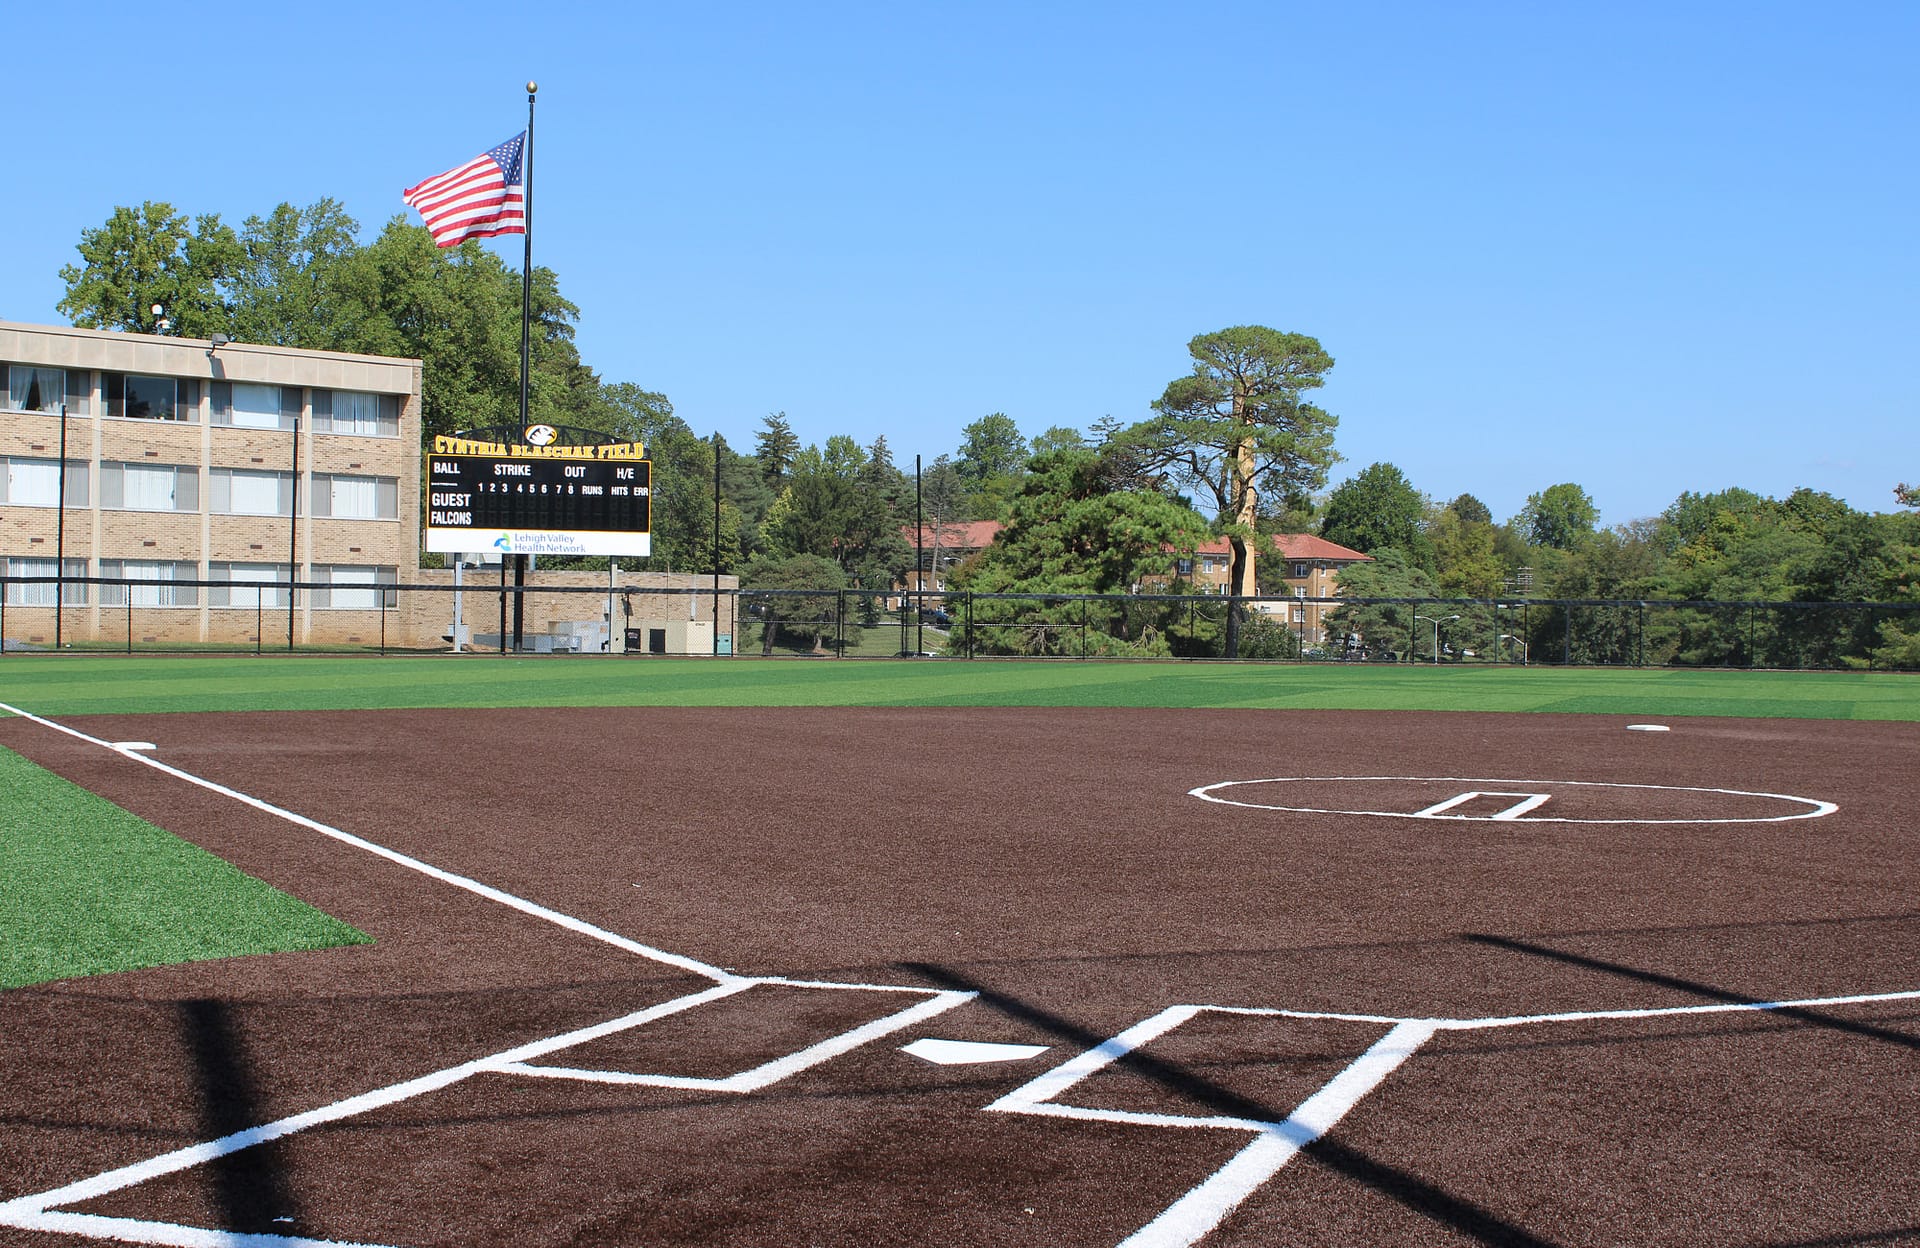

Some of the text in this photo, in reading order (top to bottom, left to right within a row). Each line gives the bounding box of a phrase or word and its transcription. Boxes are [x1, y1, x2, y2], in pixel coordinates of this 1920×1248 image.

[435, 435, 644, 459] CYNTHIA BLASCHAK FIELD
[434, 462, 634, 479] BALL STRIKE OUT H/E
[478, 482, 648, 496] 1 2 3 4 5 6 7 8 RUNS HITS ERR
[432, 493, 471, 507] GUEST
[431, 511, 472, 525] FALCONS
[514, 532, 575, 544] Lehigh Valley
[514, 543, 545, 552] Health
[546, 544, 586, 553] Network
